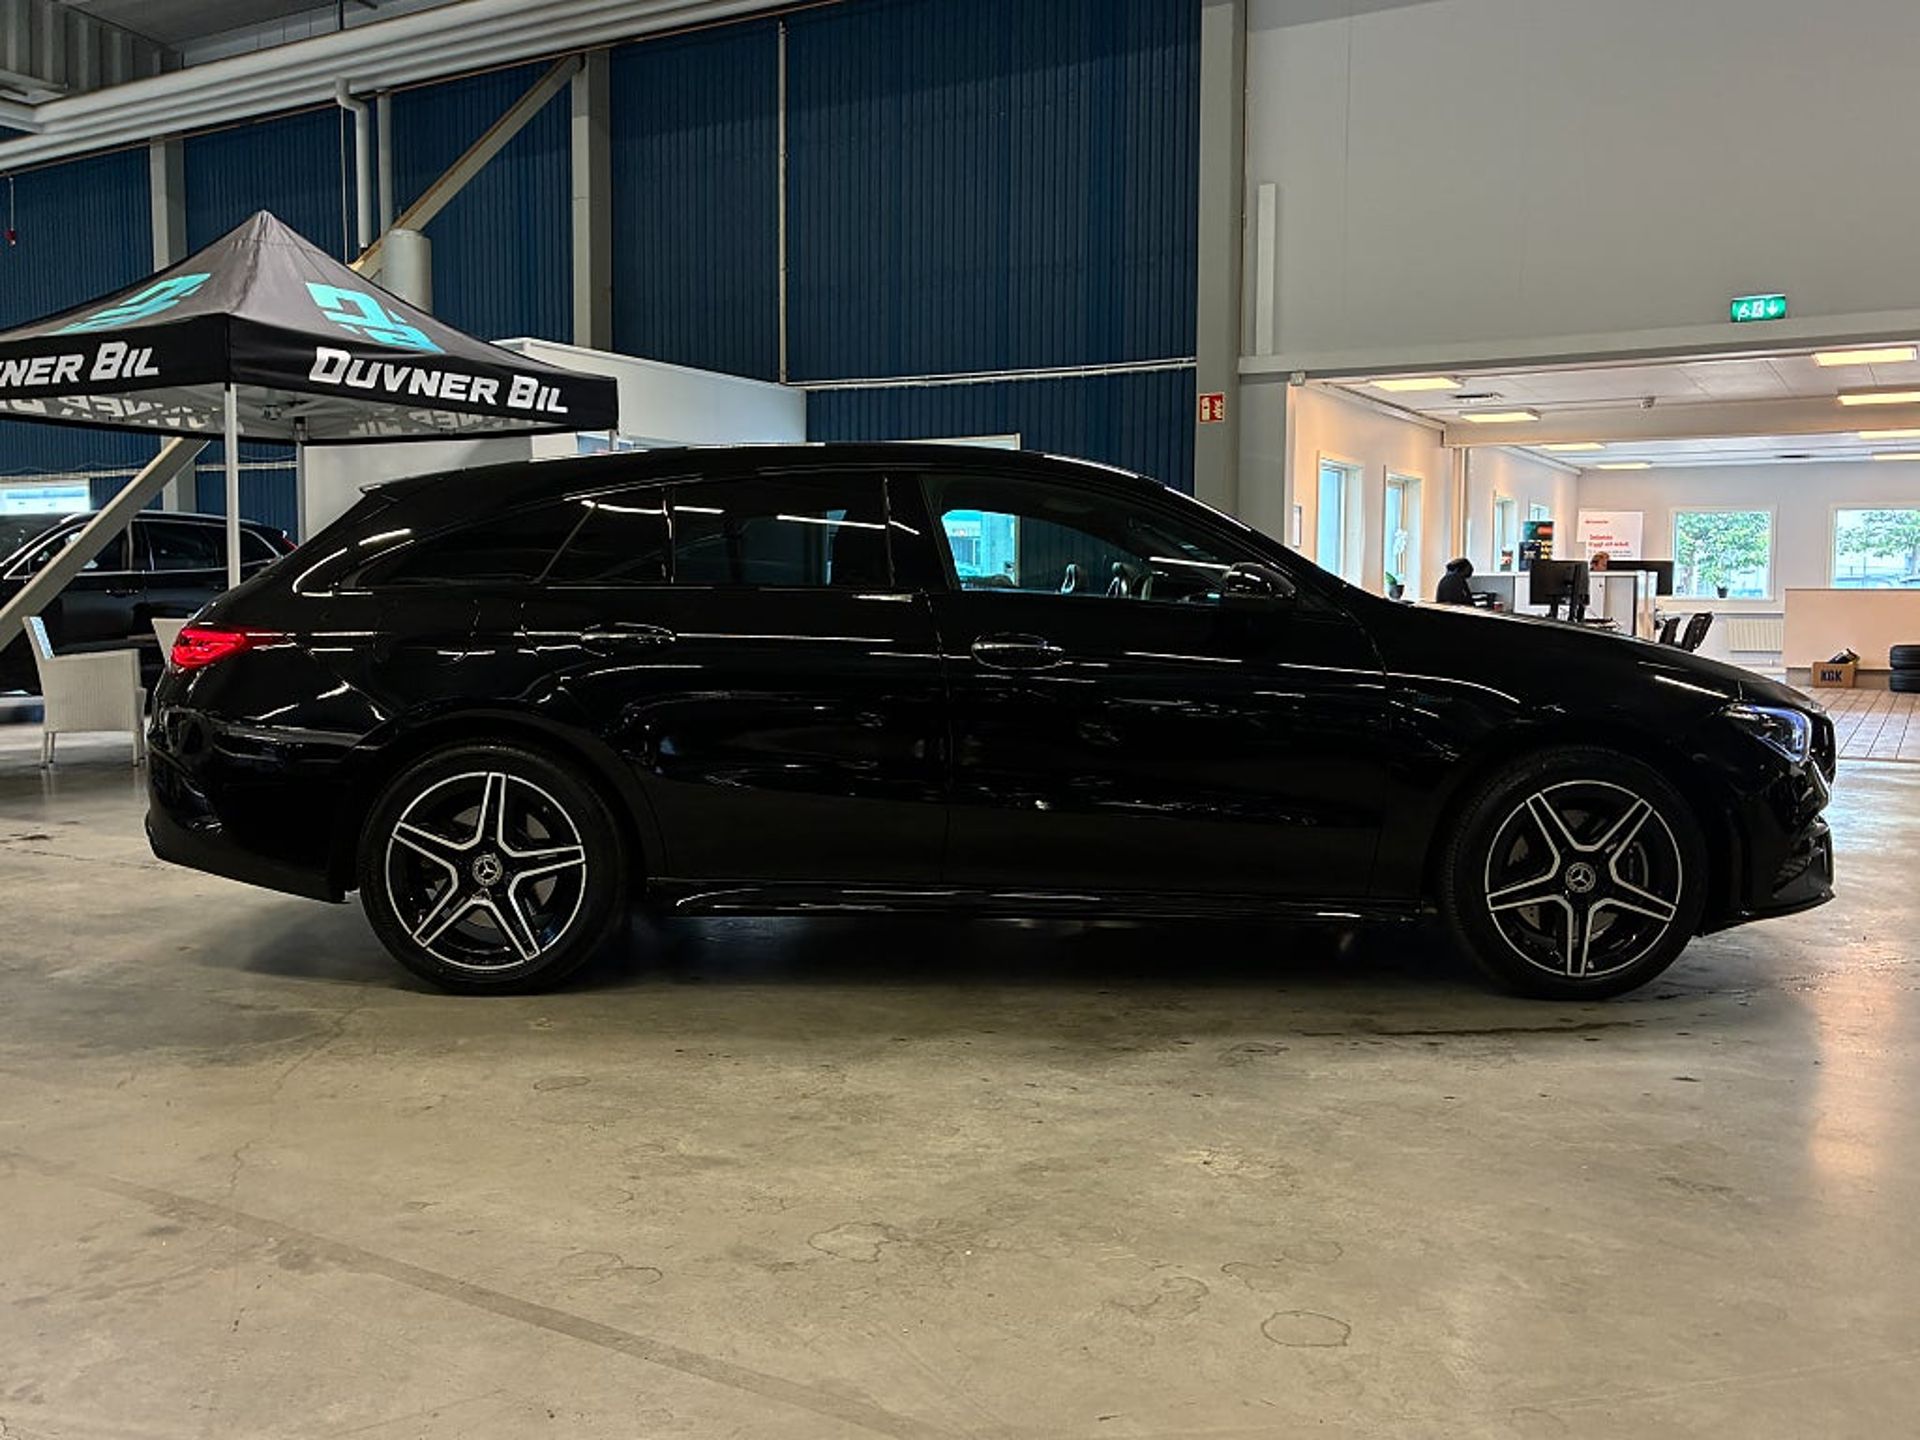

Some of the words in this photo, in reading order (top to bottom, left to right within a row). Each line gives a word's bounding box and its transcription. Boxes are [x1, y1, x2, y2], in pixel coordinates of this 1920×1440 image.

[0, 353, 85, 387] NER
[90, 341, 159, 381] BIL
[309, 346, 499, 405] DUVNER
[507, 374, 568, 413] BIL
